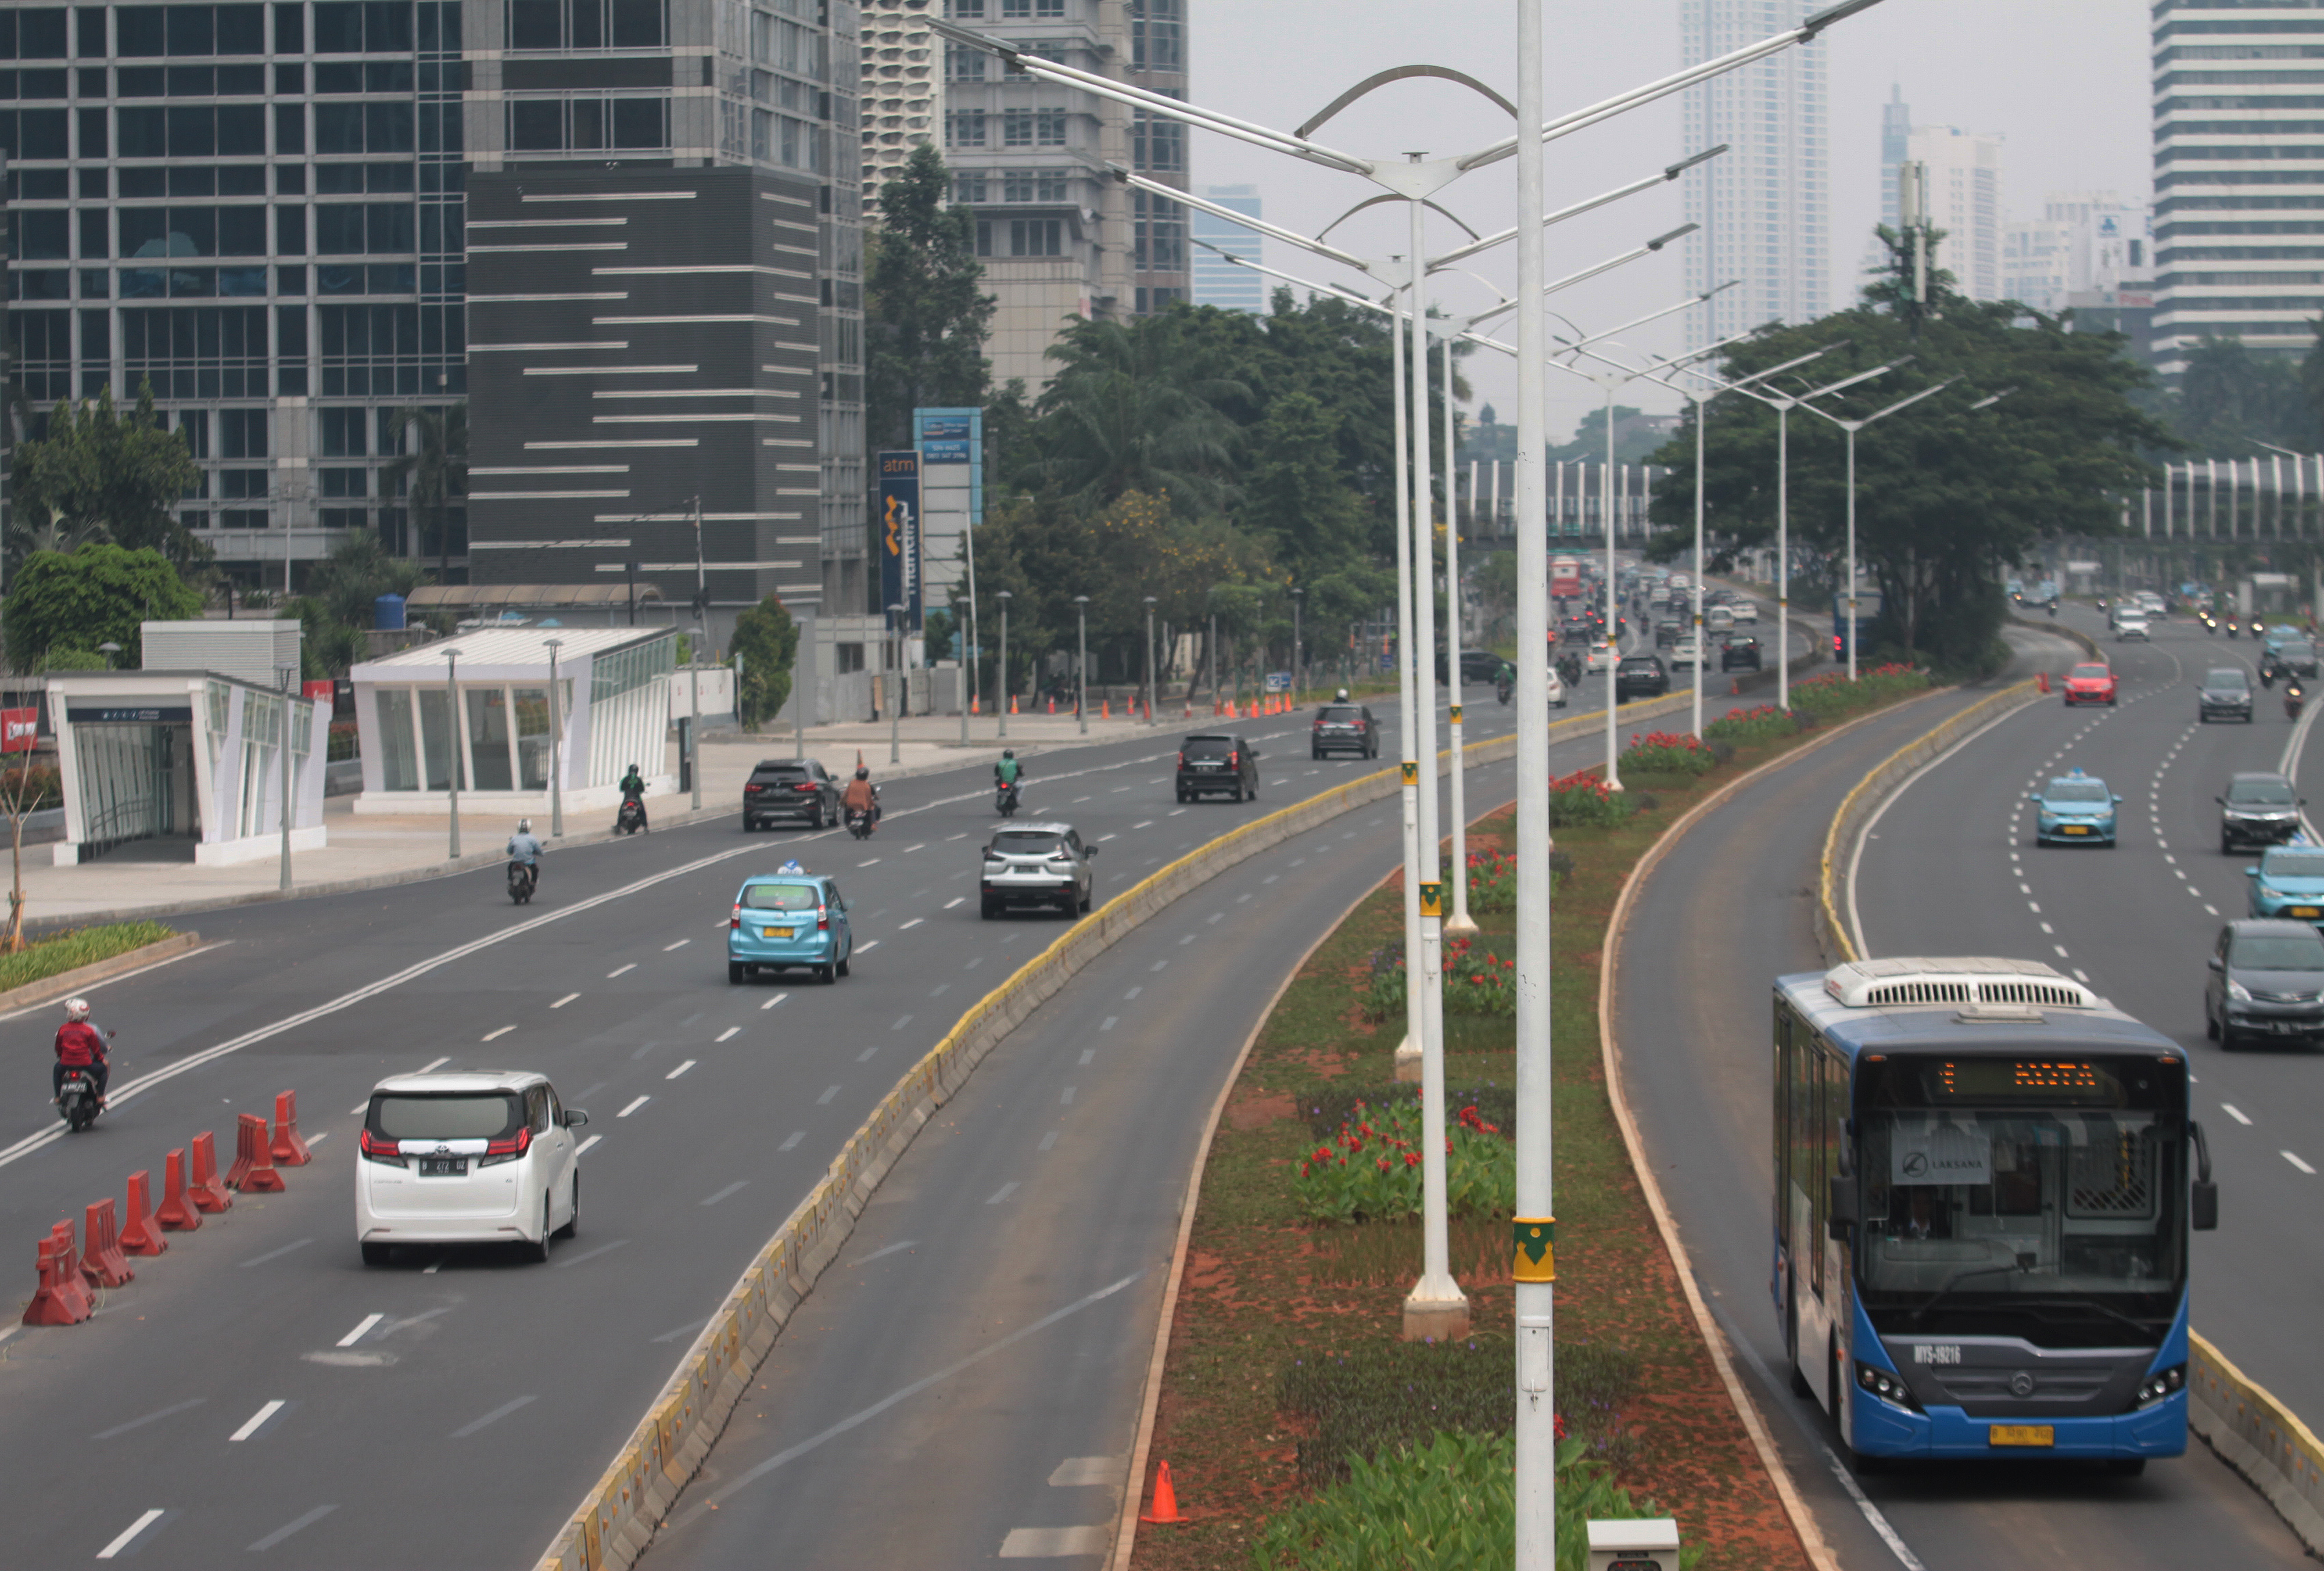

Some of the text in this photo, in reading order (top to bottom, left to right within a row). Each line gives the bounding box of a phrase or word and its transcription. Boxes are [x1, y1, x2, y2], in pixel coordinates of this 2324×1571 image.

[884, 460, 914, 472] atm
[1932, 1160, 1982, 1170] LAKSANA
[1914, 1345, 1961, 1364] MYS-19216
